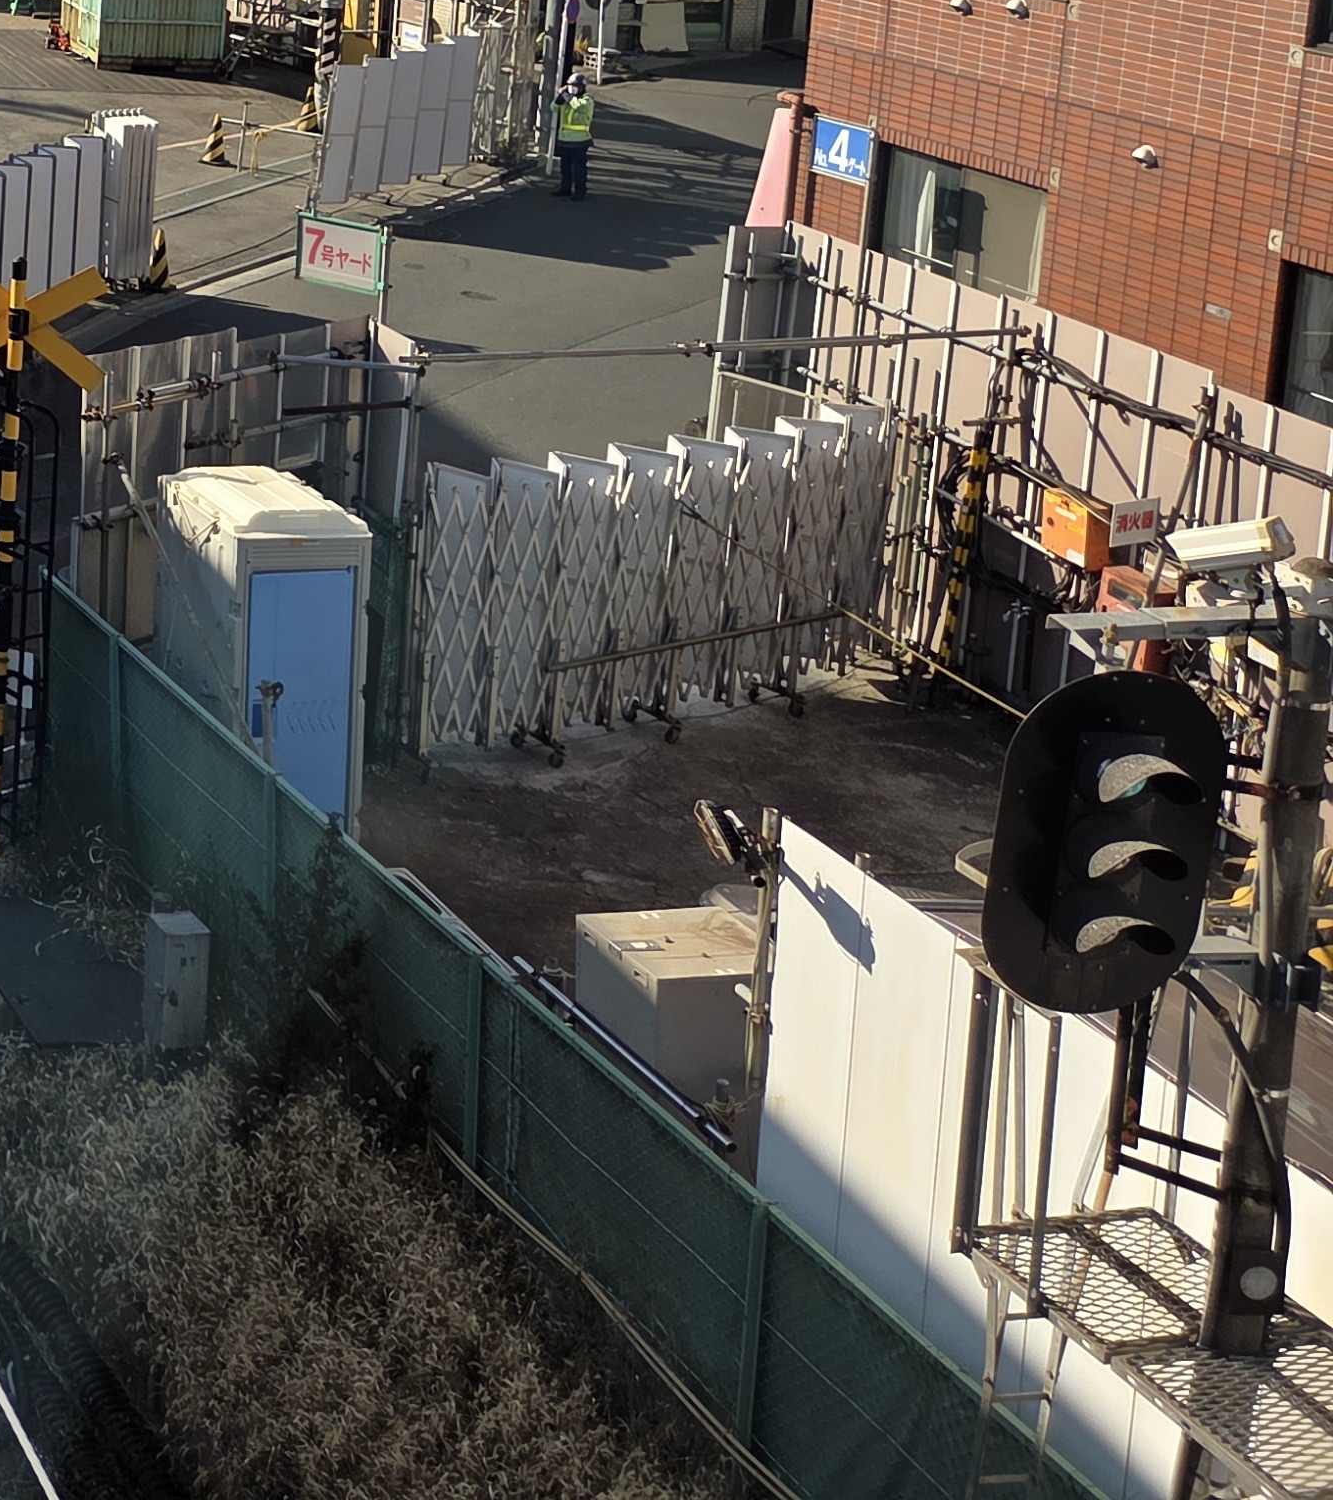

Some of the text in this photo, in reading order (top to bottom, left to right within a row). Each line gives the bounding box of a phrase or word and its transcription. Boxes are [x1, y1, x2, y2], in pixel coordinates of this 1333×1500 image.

[305, 226, 372, 274] 7号ヤード
[1114, 509, 1155, 534] 消火器
